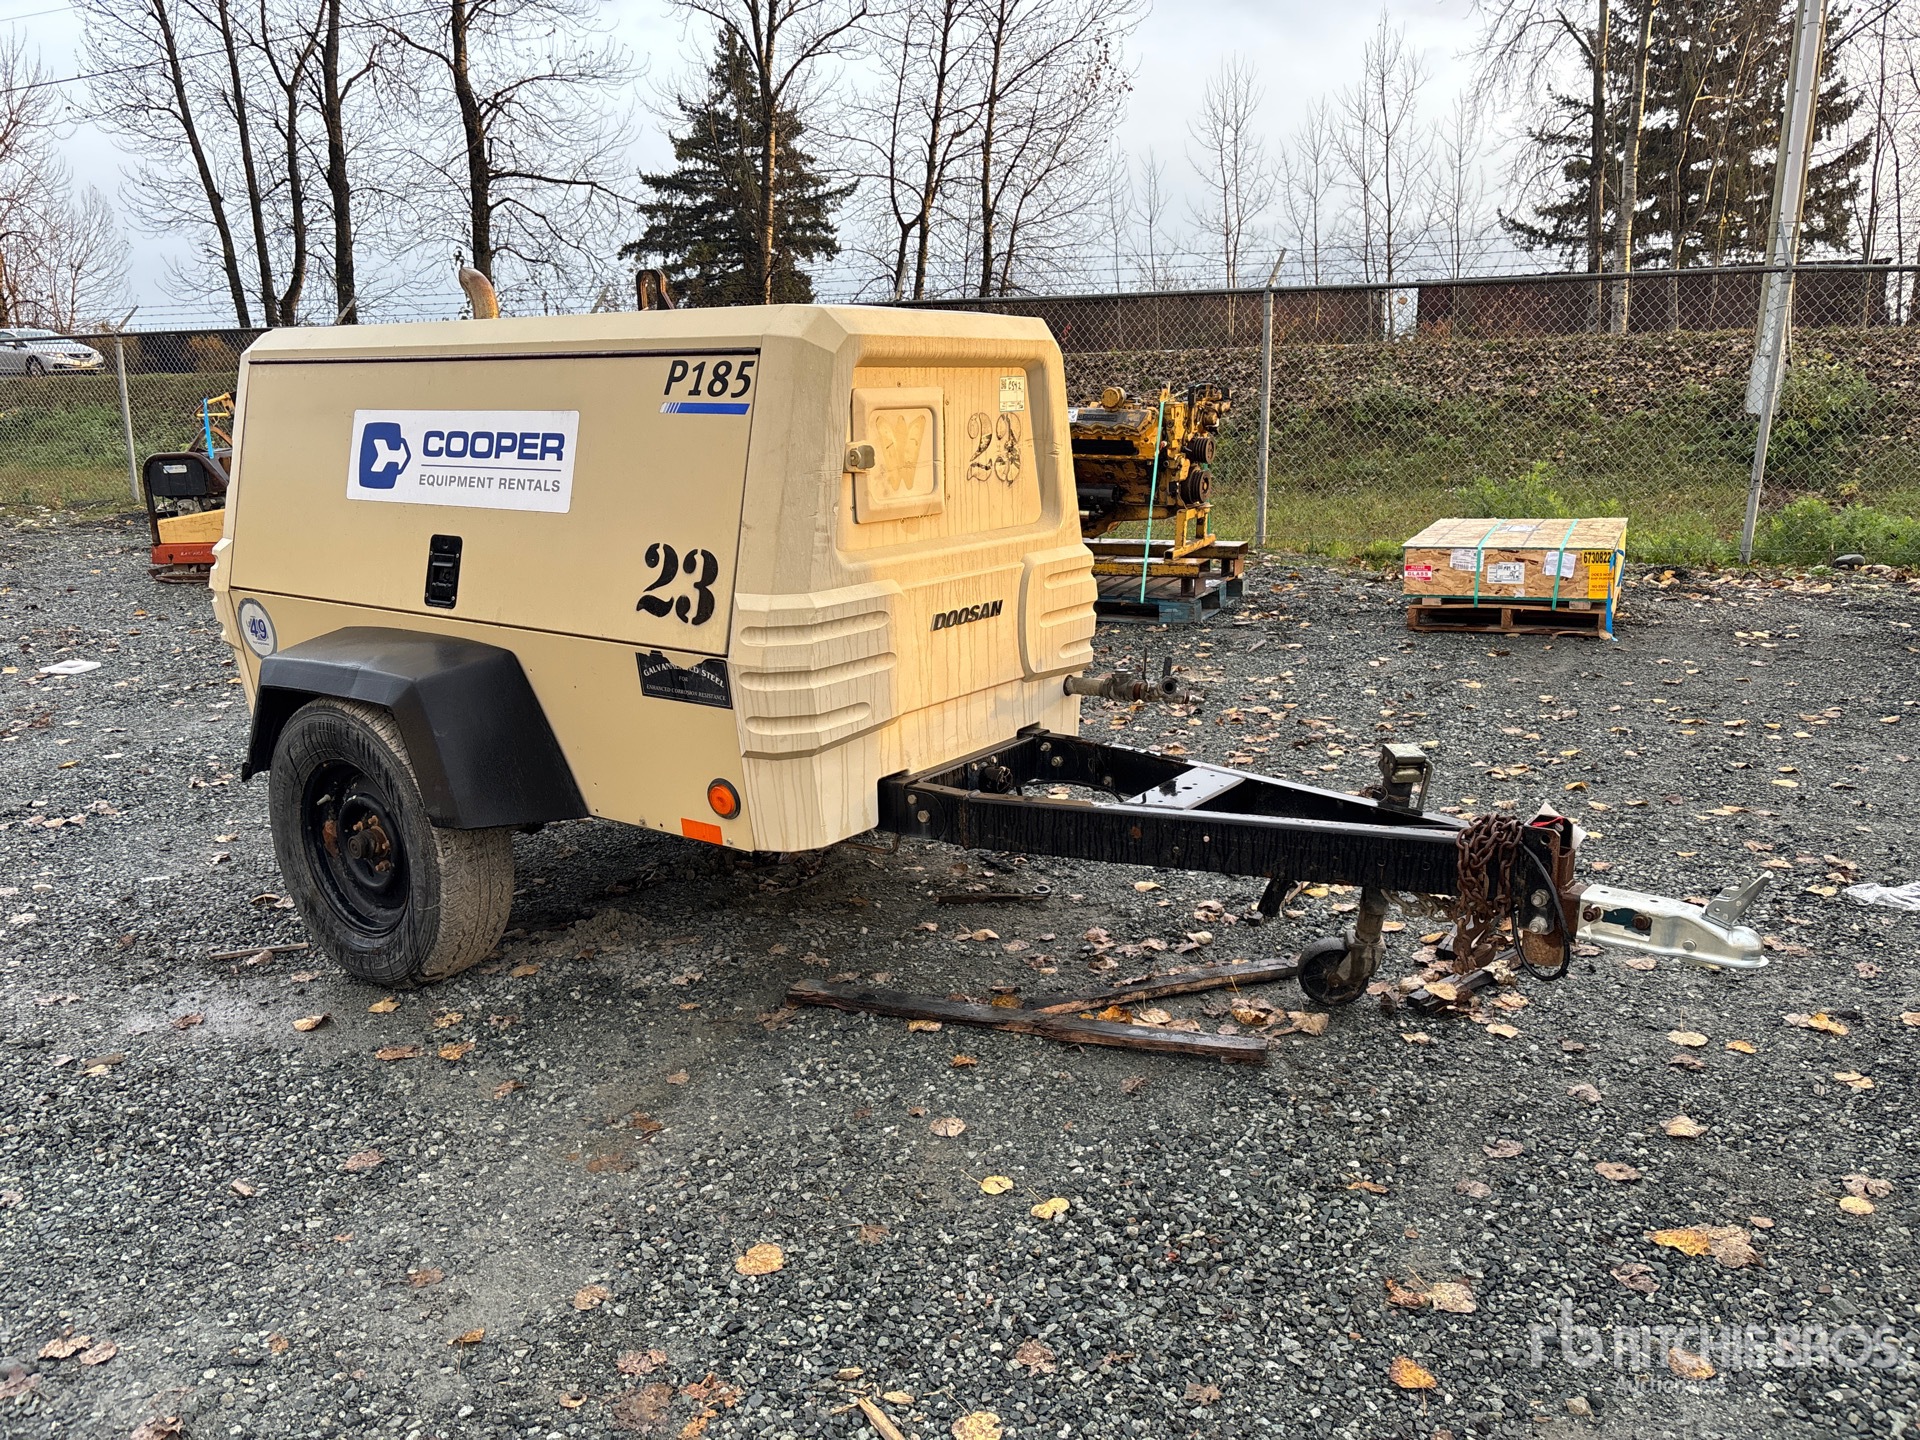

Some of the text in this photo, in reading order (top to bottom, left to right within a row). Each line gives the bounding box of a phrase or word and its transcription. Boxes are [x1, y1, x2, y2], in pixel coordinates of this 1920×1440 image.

[663, 359, 756, 398] P185
[422, 430, 566, 461] COOPER
[966, 412, 1022, 487] 23
[418, 473, 561, 493] EQUIPMENT RENTALS
[1583, 551, 1611, 564] 6730822
[636, 542, 719, 626] 23
[930, 599, 1003, 632] DOOSAN
[250, 618, 267, 640] 49
[678, 675, 689, 683] FOR
[701, 668, 725, 688] STEEL
[671, 687, 698, 697] CORROSION
[698, 691, 726, 701] RESISTANCE
